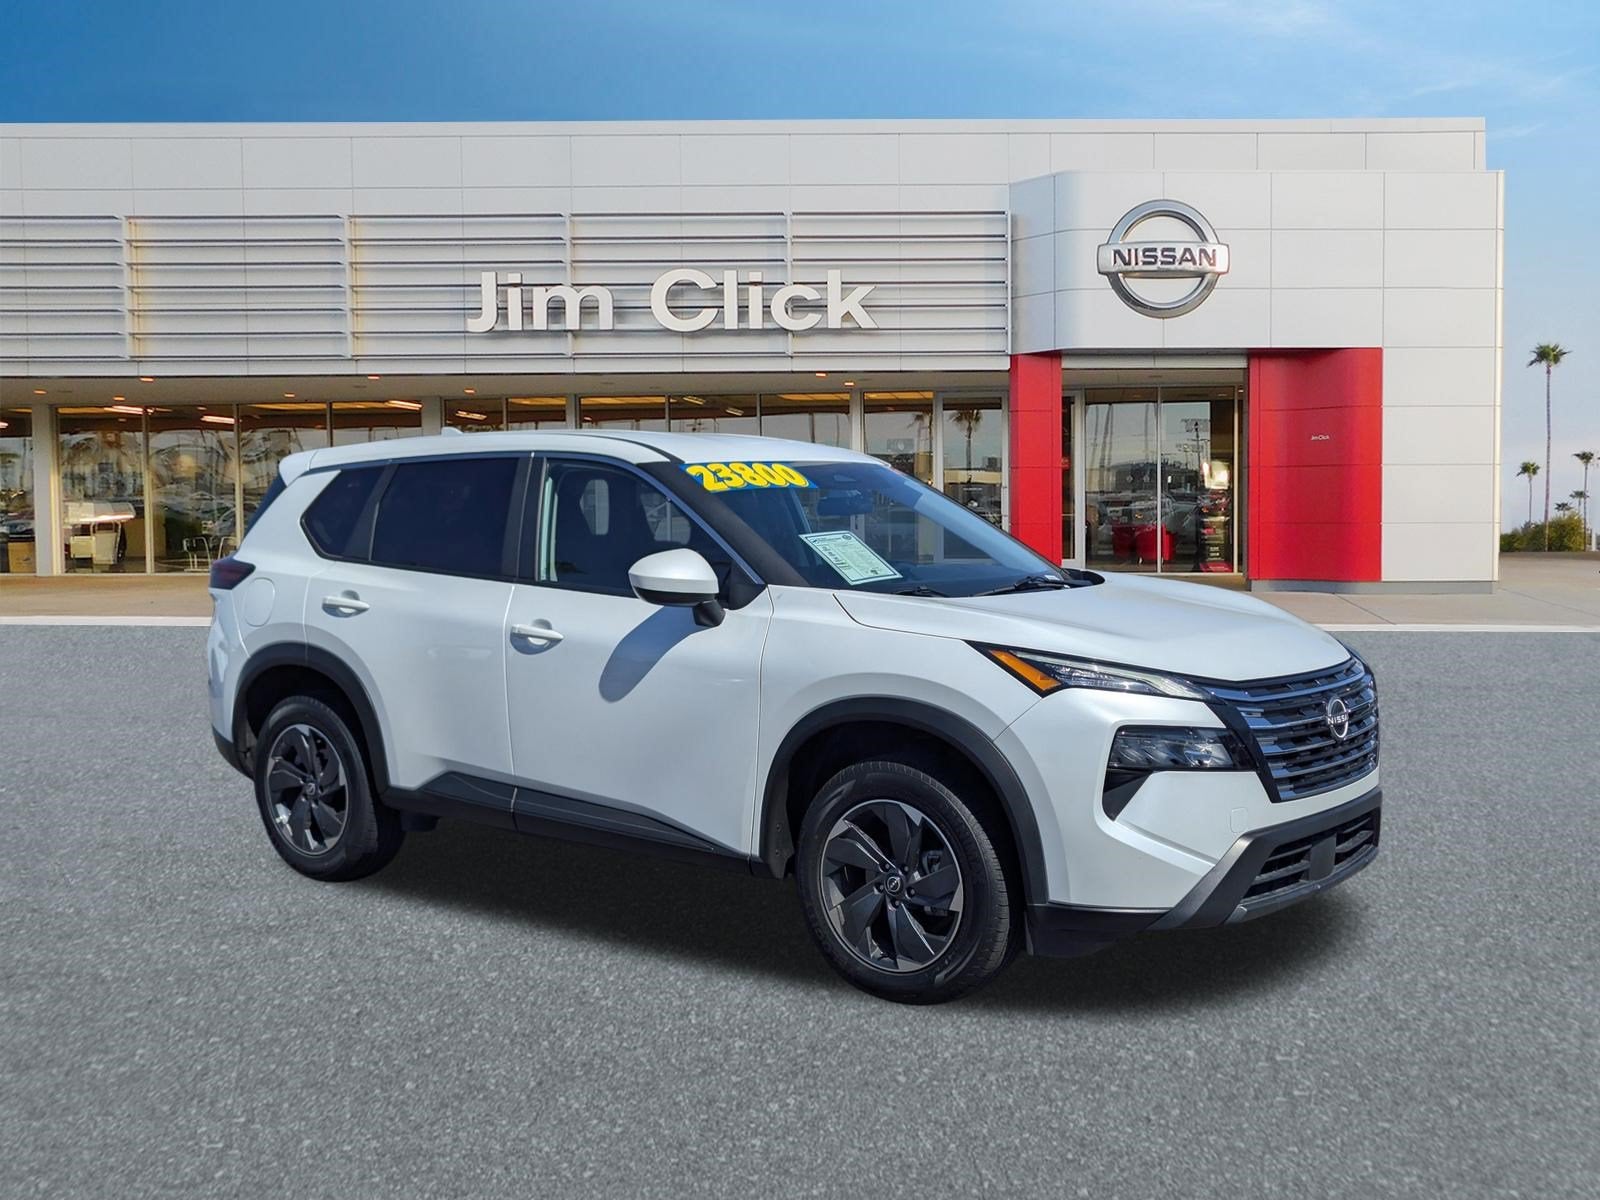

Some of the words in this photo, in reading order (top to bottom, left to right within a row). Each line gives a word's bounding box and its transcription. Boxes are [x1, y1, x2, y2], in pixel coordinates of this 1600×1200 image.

[1112, 247, 1217, 267] NISSAN
[466, 270, 614, 333] Jim
[650, 268, 879, 332] Click
[686, 462, 809, 492] 23800
